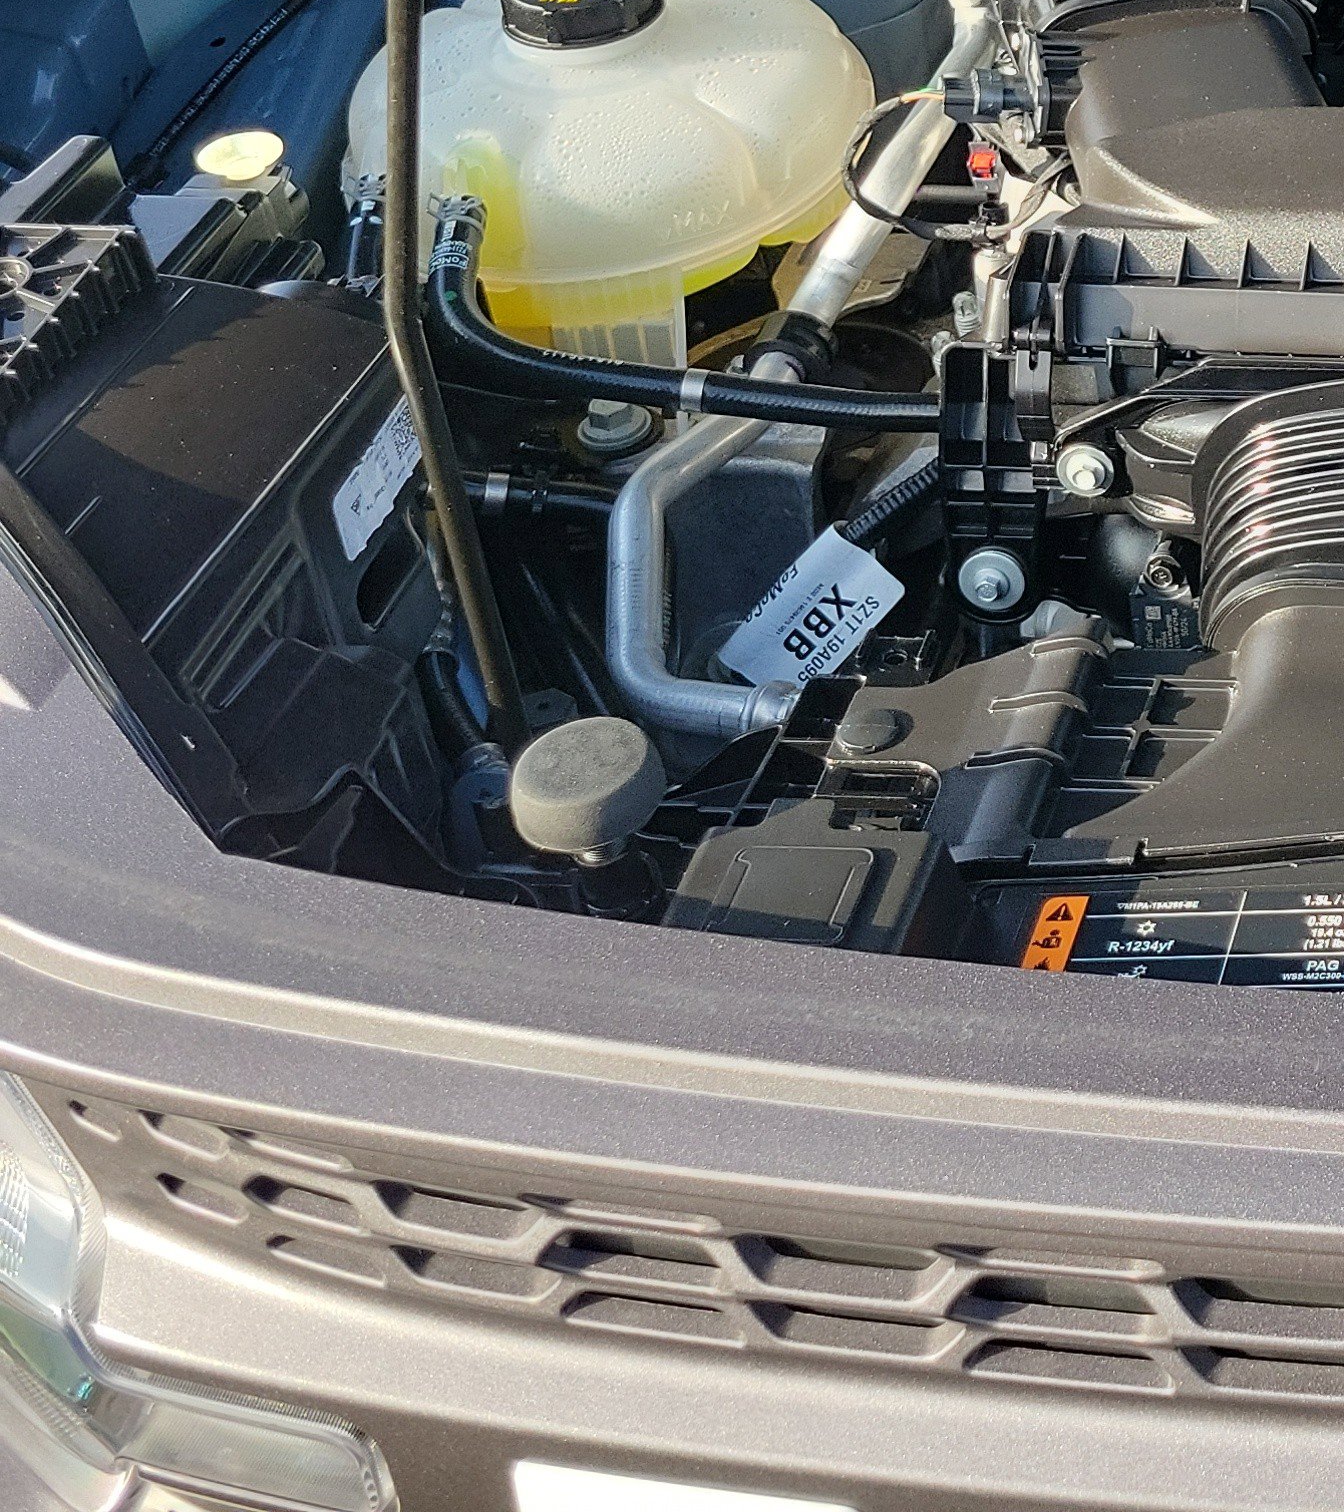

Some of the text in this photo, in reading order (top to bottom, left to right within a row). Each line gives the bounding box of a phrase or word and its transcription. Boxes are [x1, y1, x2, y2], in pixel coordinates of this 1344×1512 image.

[782, 583, 858, 661] XBB
[849, 595, 880, 636] SZ1T
[797, 633, 846, 682] 19A095
[1107, 939, 1175, 954] R-1234yf
[1306, 959, 1340, 972] PAG
